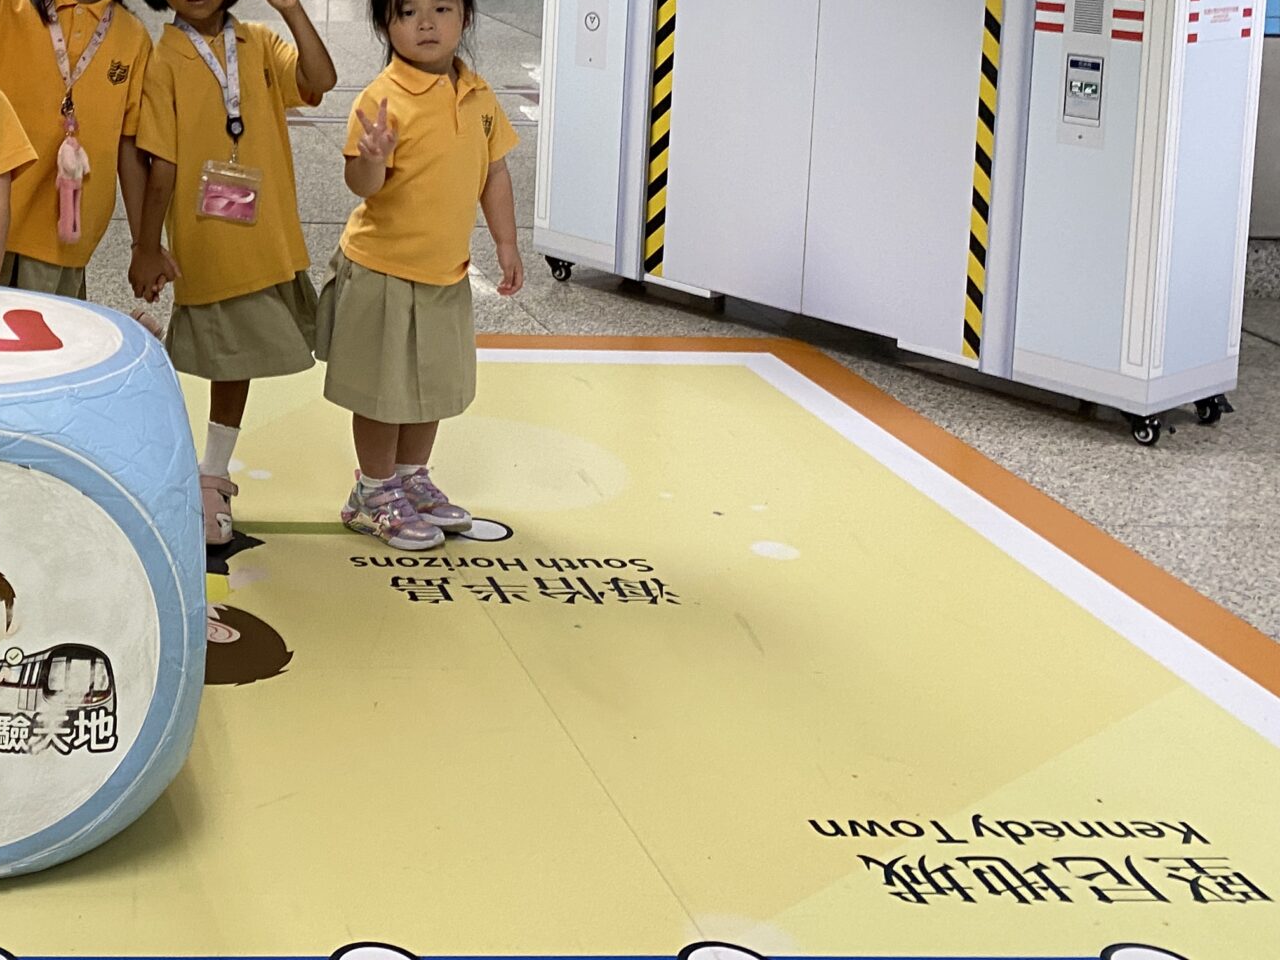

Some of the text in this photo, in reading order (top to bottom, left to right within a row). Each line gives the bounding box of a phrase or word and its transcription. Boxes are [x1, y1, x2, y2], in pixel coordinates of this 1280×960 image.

[349, 555, 655, 573] South Horizons
[390, 575, 682, 606] 海怡半島
[807, 814, 1211, 845] Kennedy Town
[855, 855, 1274, 905] 堅尼地城
